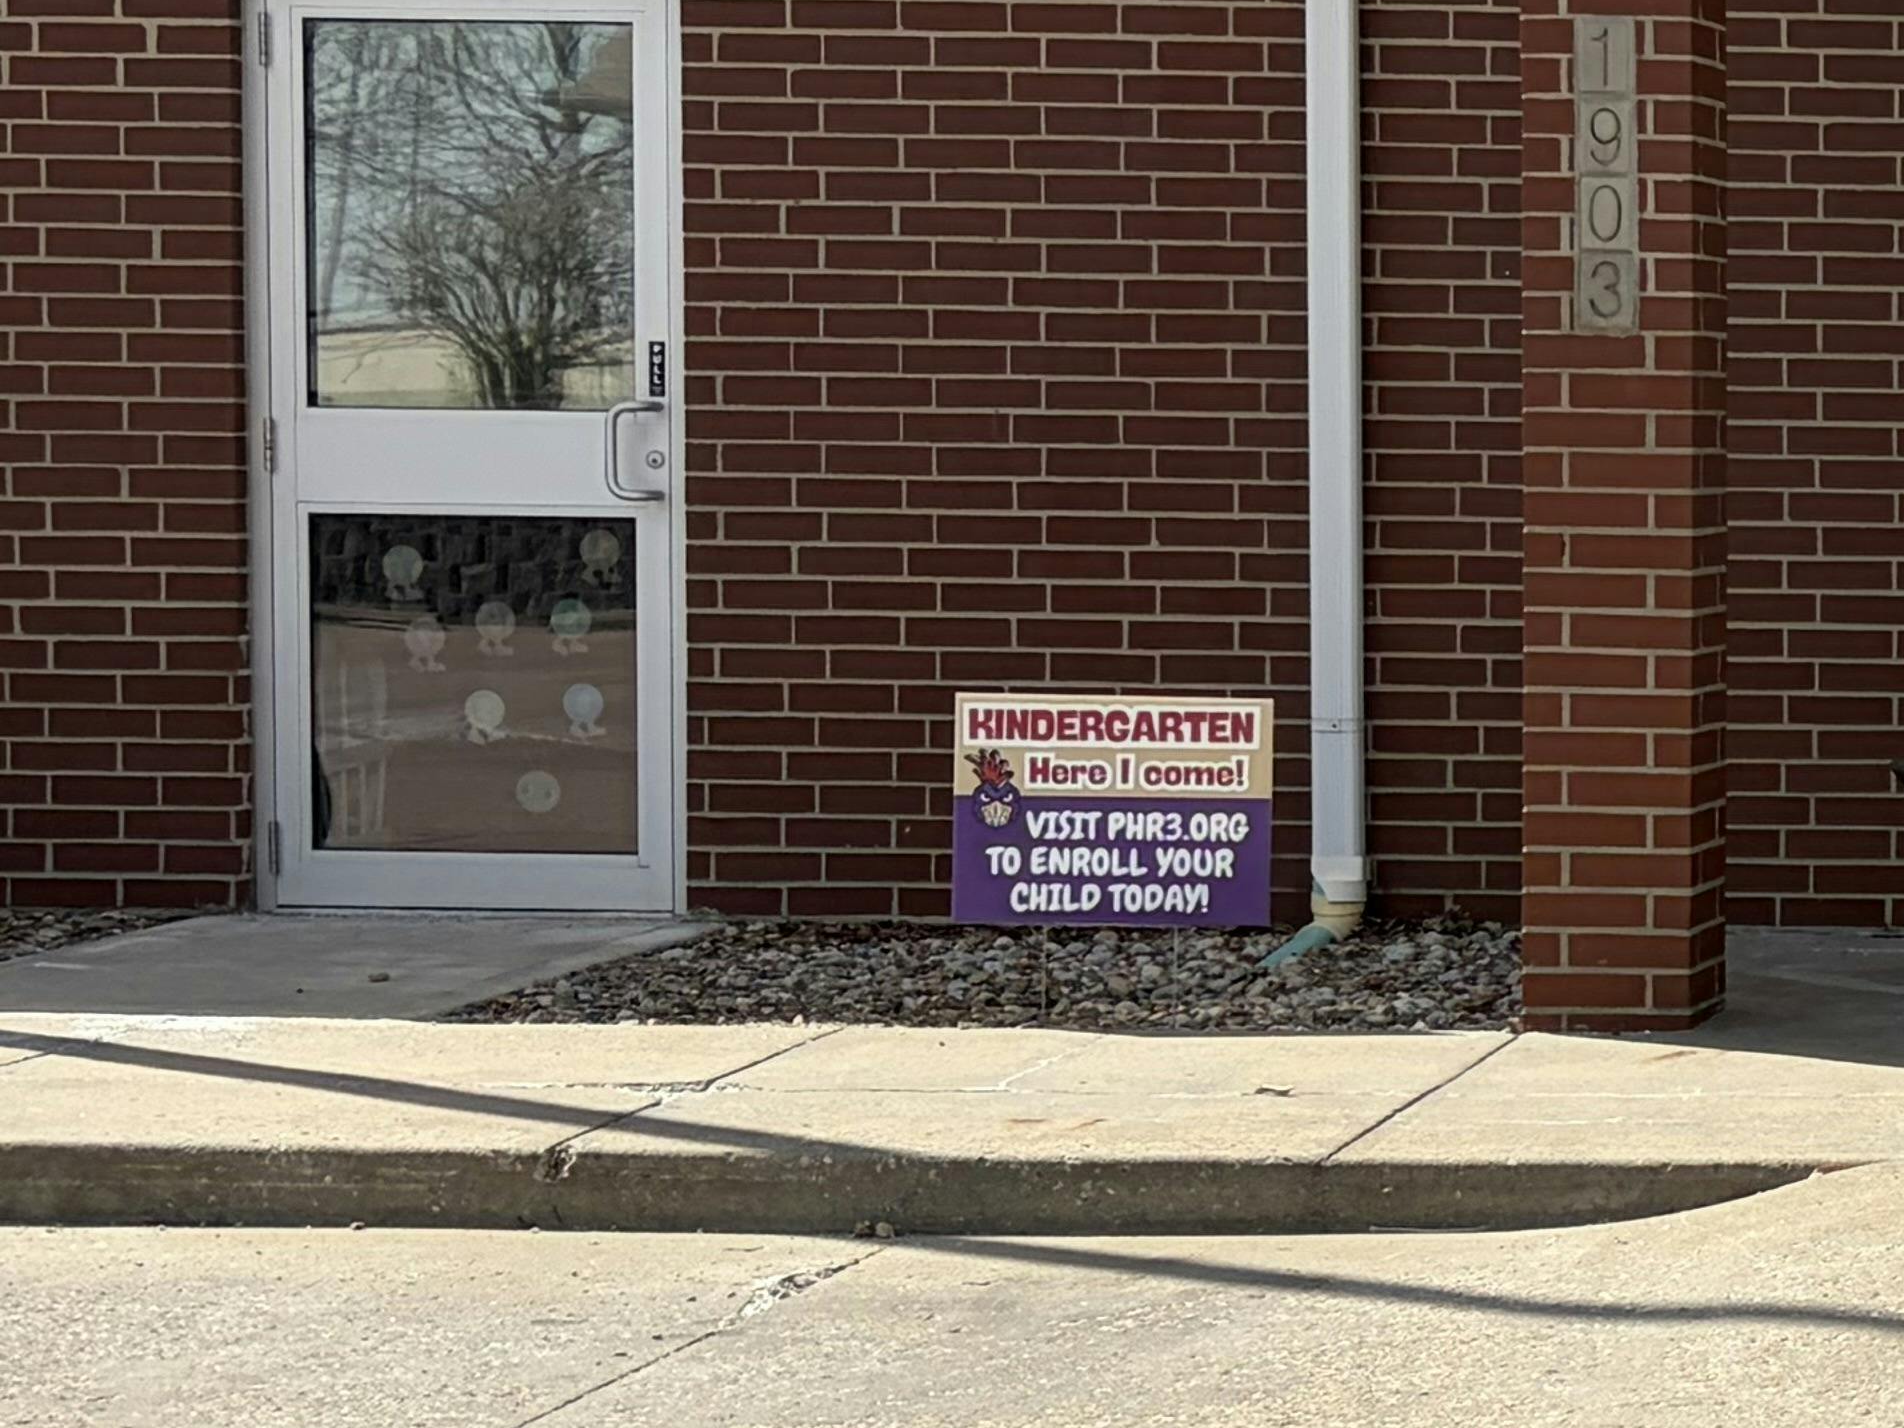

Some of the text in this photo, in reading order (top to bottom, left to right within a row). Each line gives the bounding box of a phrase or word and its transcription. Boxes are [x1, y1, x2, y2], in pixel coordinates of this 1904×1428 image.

[1588, 27, 1622, 318] 1903
[652, 344, 663, 384] PULL
[967, 707, 1256, 744] KINDERGARTEN
[1028, 756, 1245, 787] Here I come!
[1026, 810, 1249, 842] VISIT PHR3.ORG
[985, 847, 1234, 878] TO ENROLL YOUR
[1010, 882, 1209, 914] CHILD TODAY!
